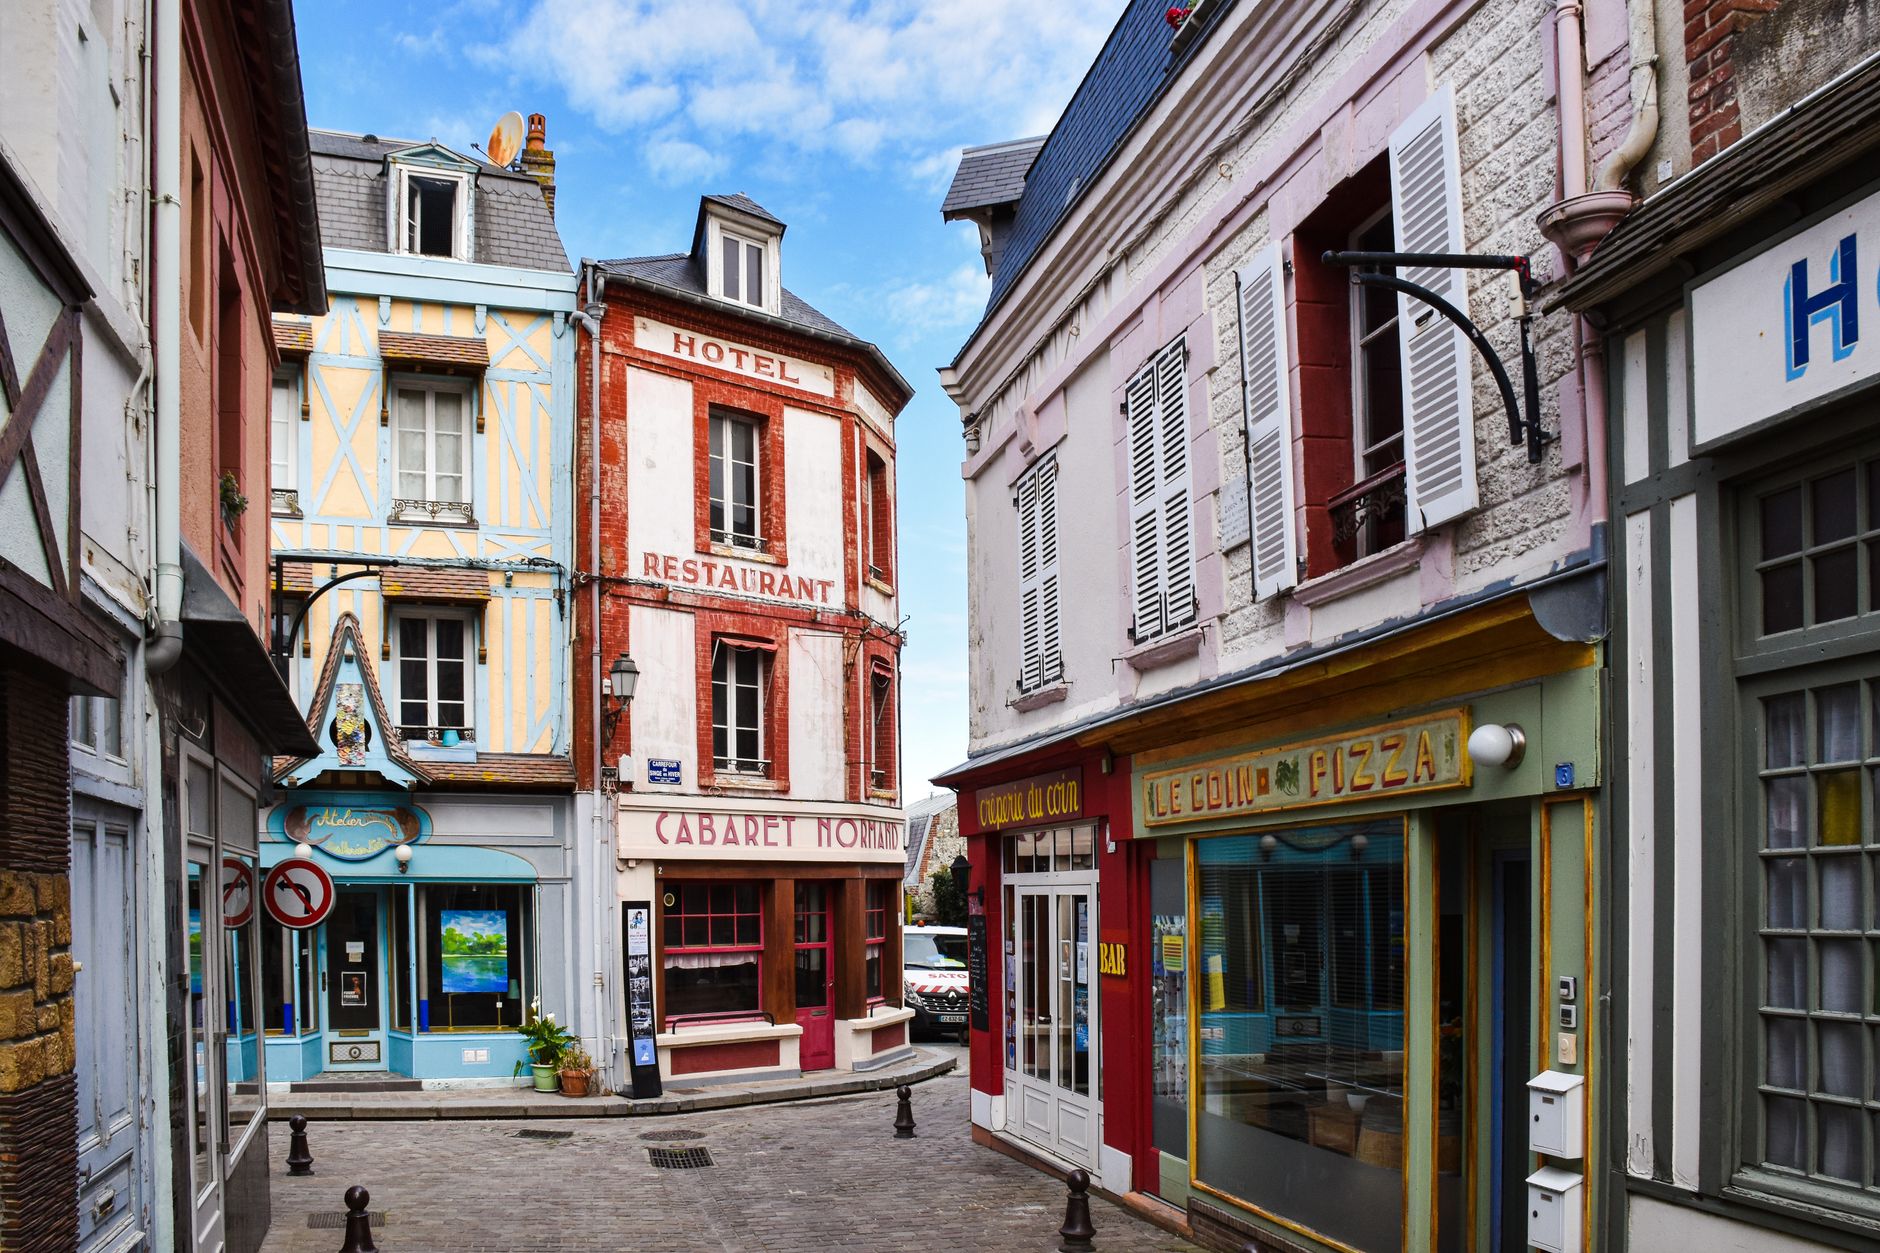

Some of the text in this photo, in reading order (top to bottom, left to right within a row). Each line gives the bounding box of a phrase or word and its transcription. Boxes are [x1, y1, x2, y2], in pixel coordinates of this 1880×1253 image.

[673, 332, 800, 384] HOTEL
[643, 552, 835, 602] RESTAURANT
[1156, 730, 1436, 817] LE COIN PIZZA
[1561, 767, 1568, 783] 3
[317, 807, 365, 827] Atelier
[980, 773, 1079, 830] crêperie du coin
[656, 812, 898, 850] CABARET NORMAND
[658, 866, 663, 875] 2
[1100, 942, 1126, 976] BAR
